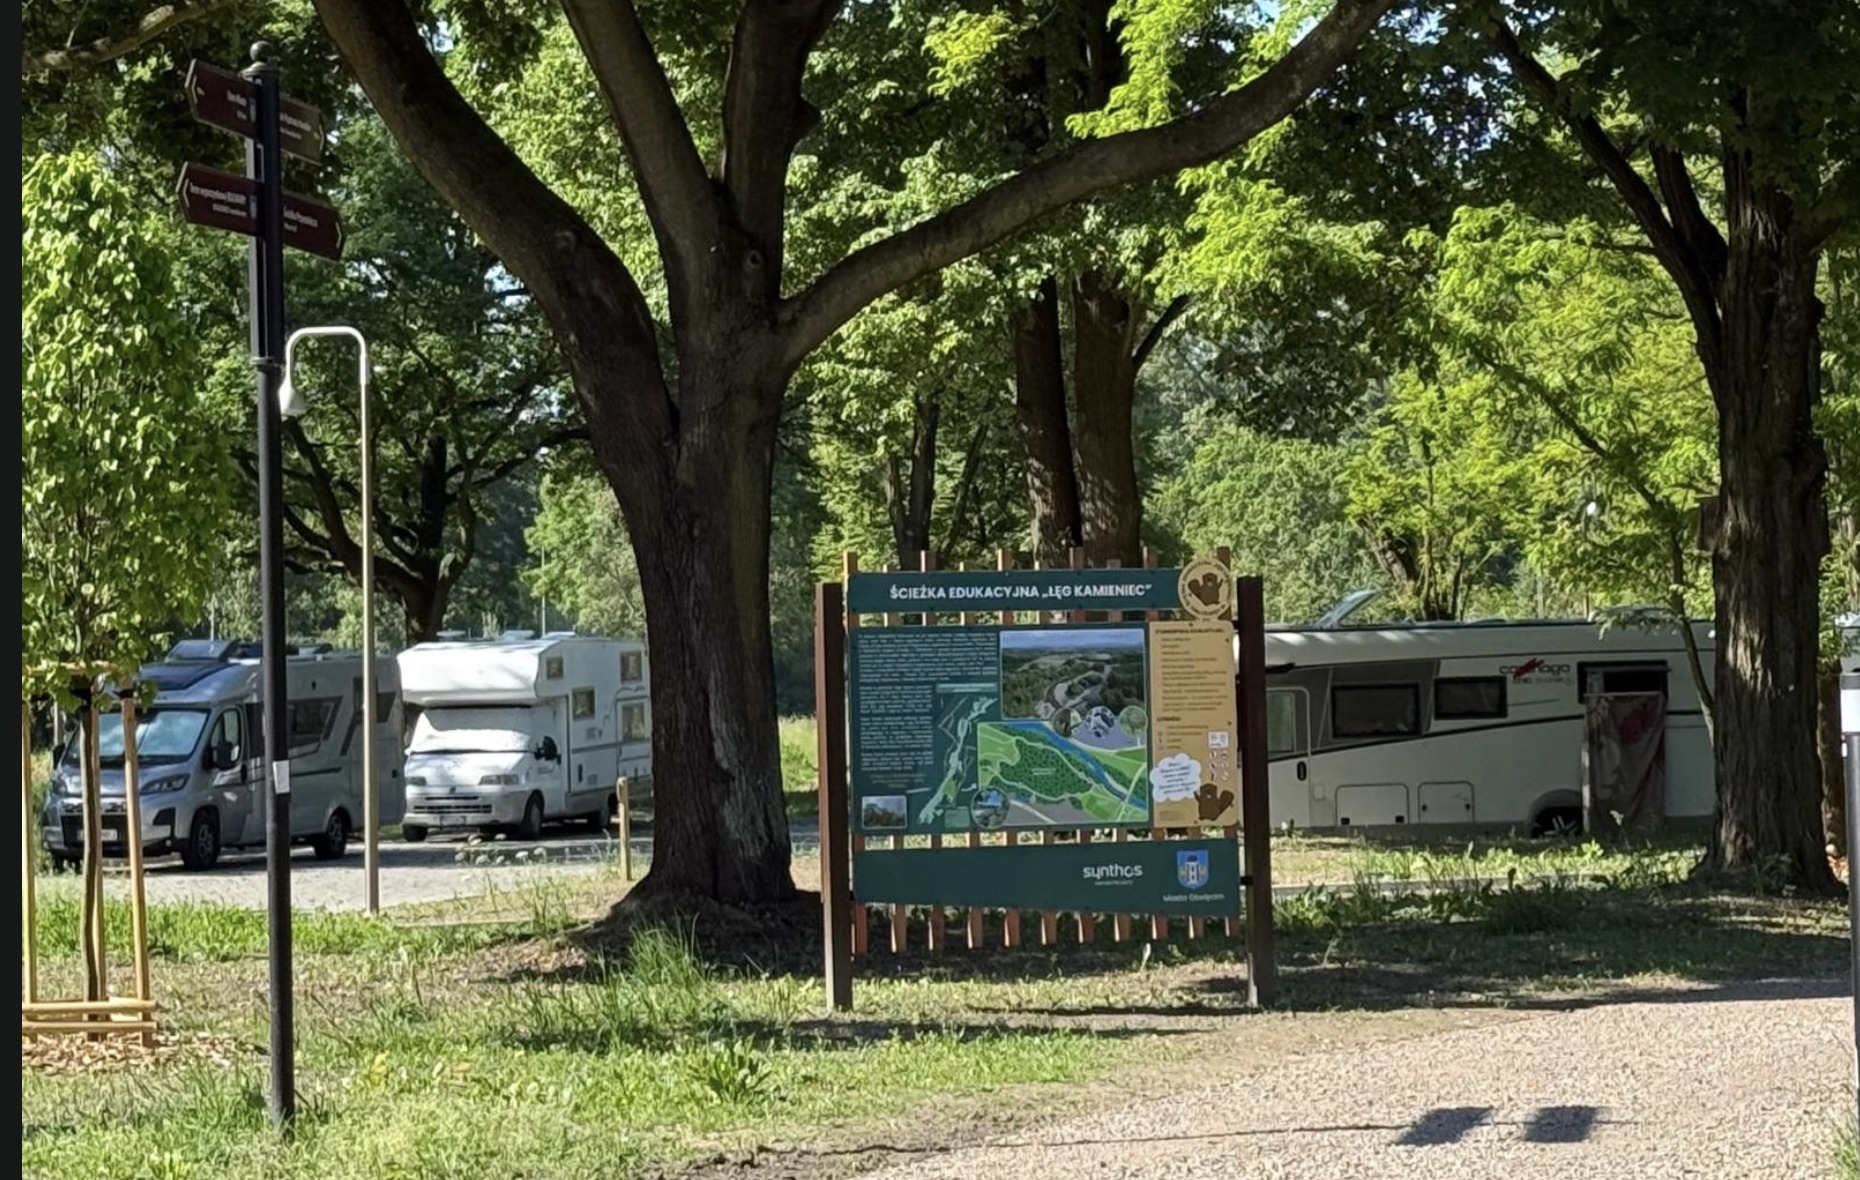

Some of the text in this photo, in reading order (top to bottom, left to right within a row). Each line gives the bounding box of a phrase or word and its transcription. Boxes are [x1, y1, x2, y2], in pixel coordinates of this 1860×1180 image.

[890, 584, 946, 599] ŚCIEŻKA
[949, 585, 1039, 599] EDUKACYJNA
[1082, 863, 1143, 879] synthos
